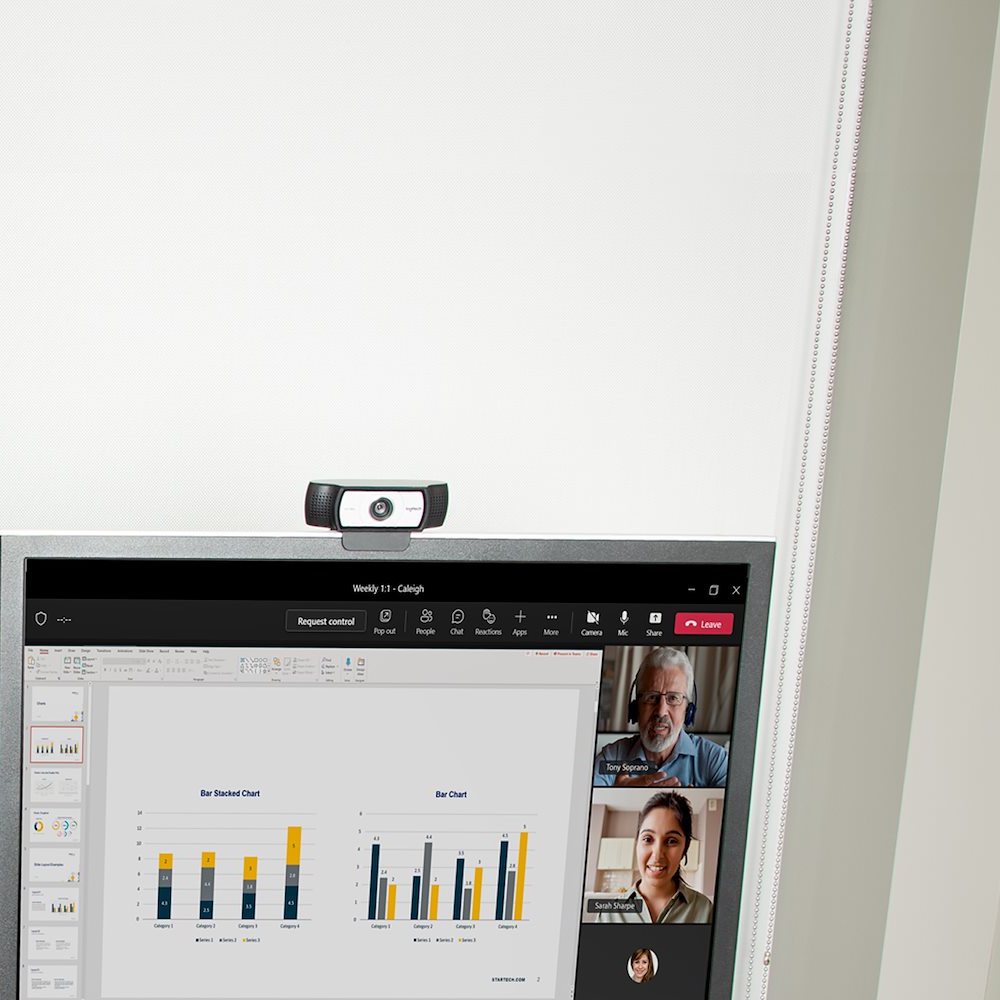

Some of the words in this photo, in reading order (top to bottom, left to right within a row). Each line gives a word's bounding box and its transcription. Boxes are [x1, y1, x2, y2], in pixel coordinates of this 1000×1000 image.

[353, 584, 379, 594] Weekly
[398, 584, 424, 595] Caleigh
[298, 617, 327, 627] Request
[328, 617, 355, 625] control
[374, 627, 385, 636] Pop
[416, 628, 436, 636] People
[607, 763, 623, 772] Tony
[623, 763, 648, 772] Soprano
[594, 902, 614, 910] Sarah
[614, 901, 636, 912] Sharpe
